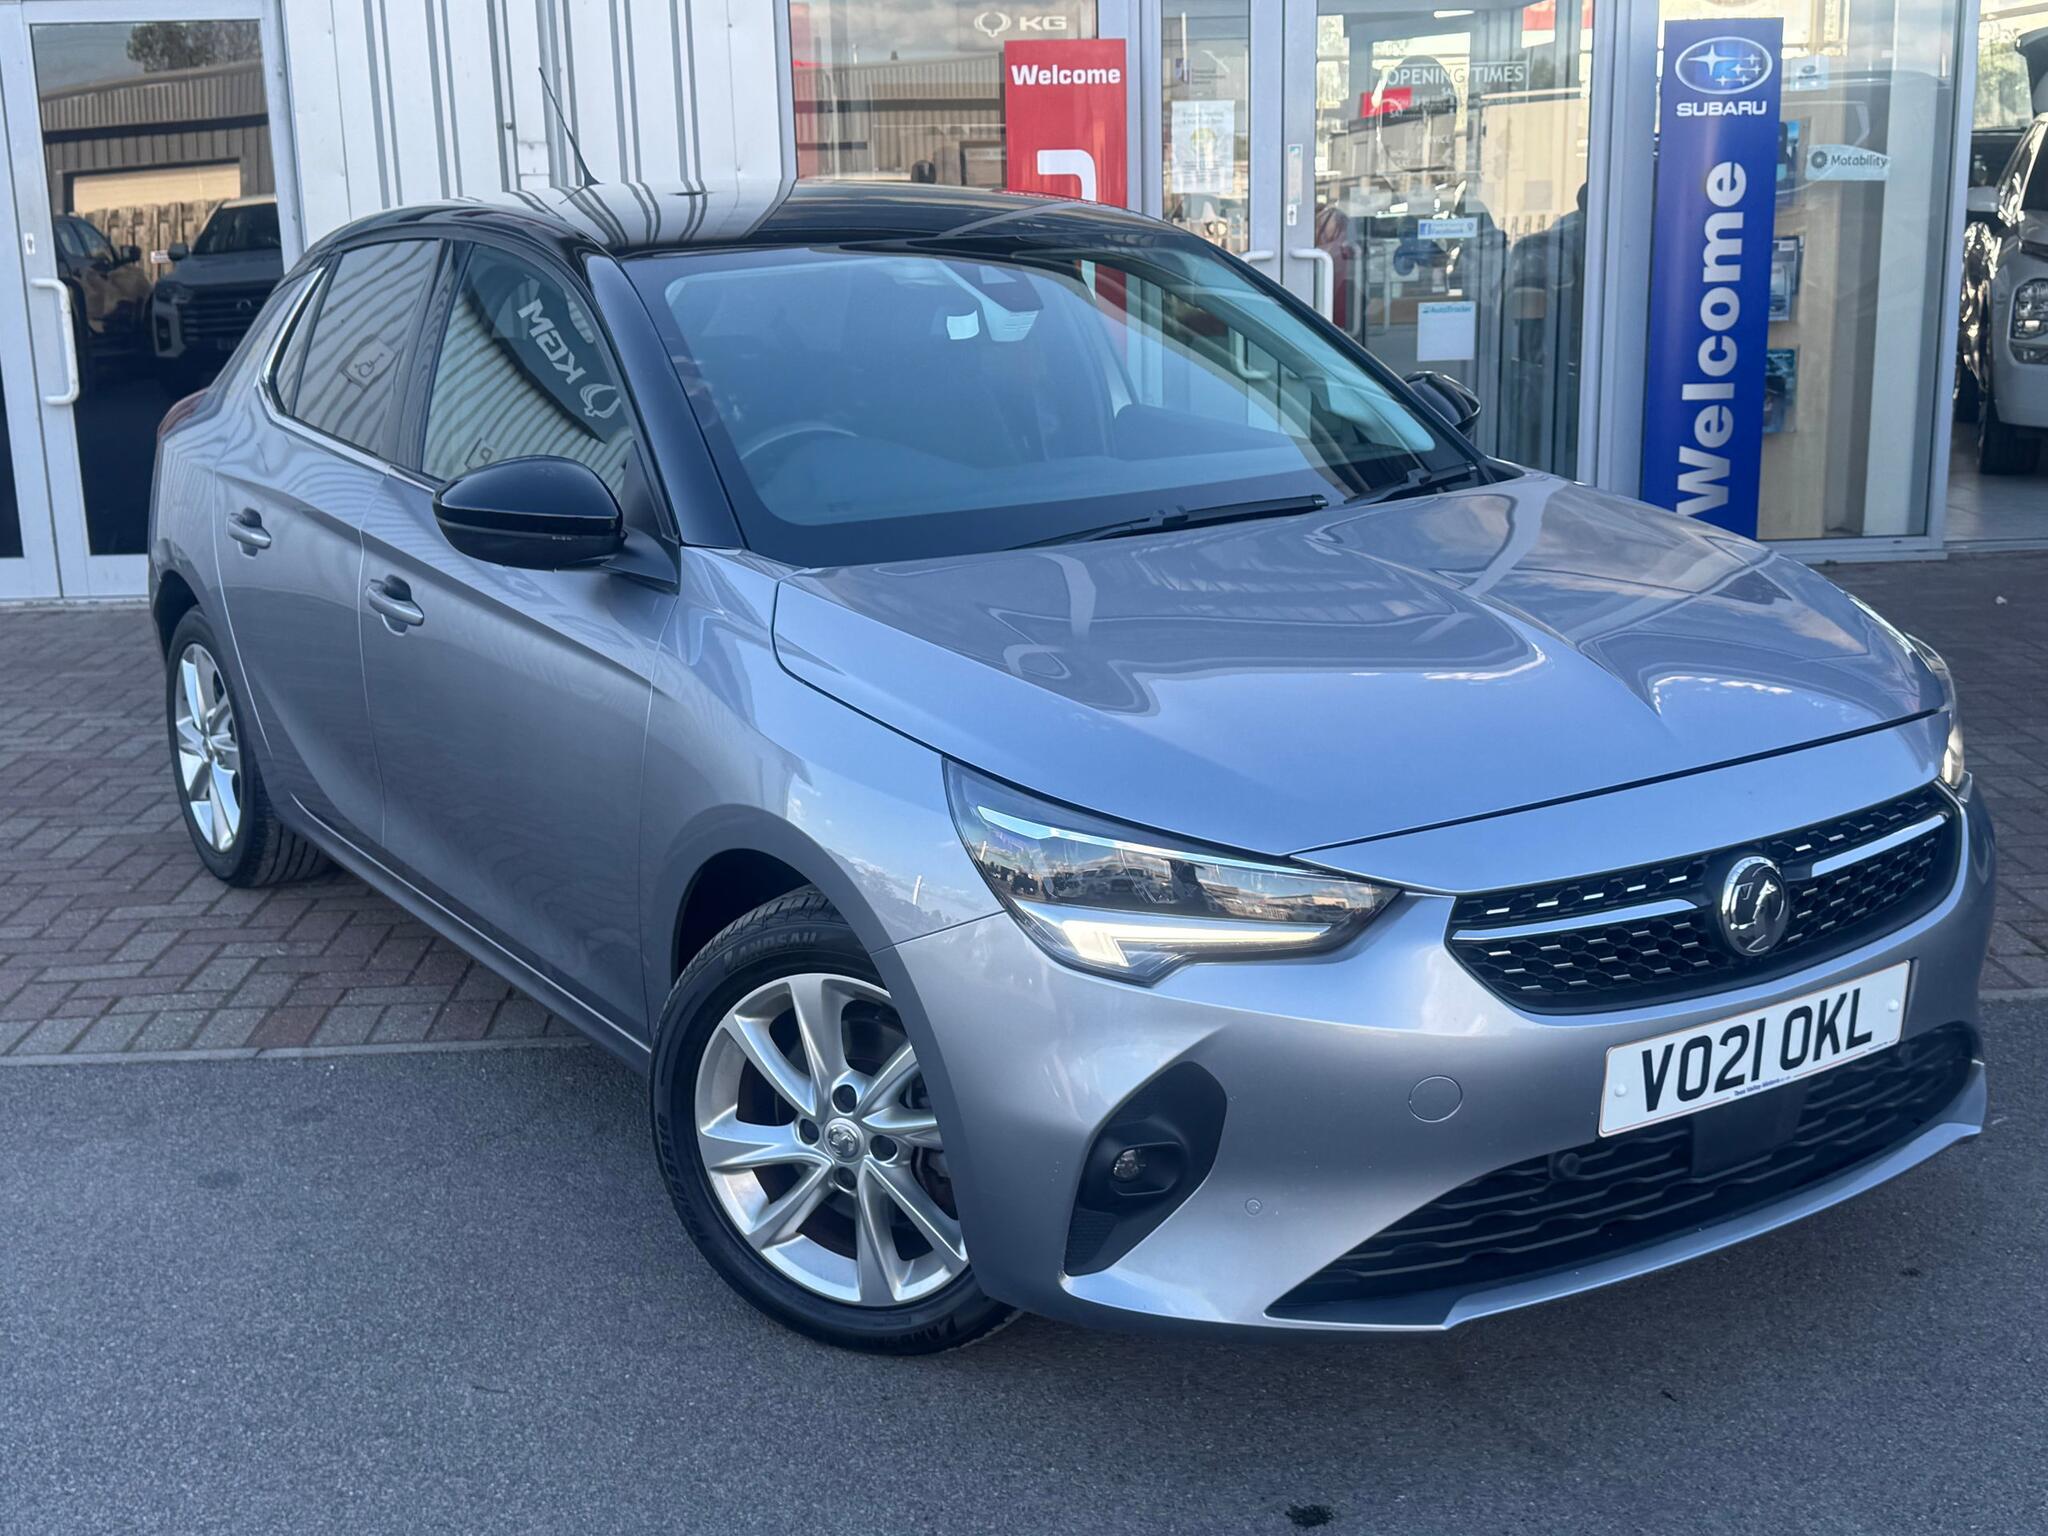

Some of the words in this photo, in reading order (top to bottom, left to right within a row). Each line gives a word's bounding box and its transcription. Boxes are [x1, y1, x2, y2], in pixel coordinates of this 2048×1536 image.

[1011, 64, 1120, 86] Welcome
[1387, 67, 1466, 85] OPENING
[1471, 65, 1524, 83] TIMES
[1676, 101, 1768, 117] SUBARU
[1830, 154, 1888, 168] Motability
[1676, 160, 1747, 517] Welcome
[1641, 1017, 1767, 1113] VO21
[1779, 988, 1872, 1070] OKL
